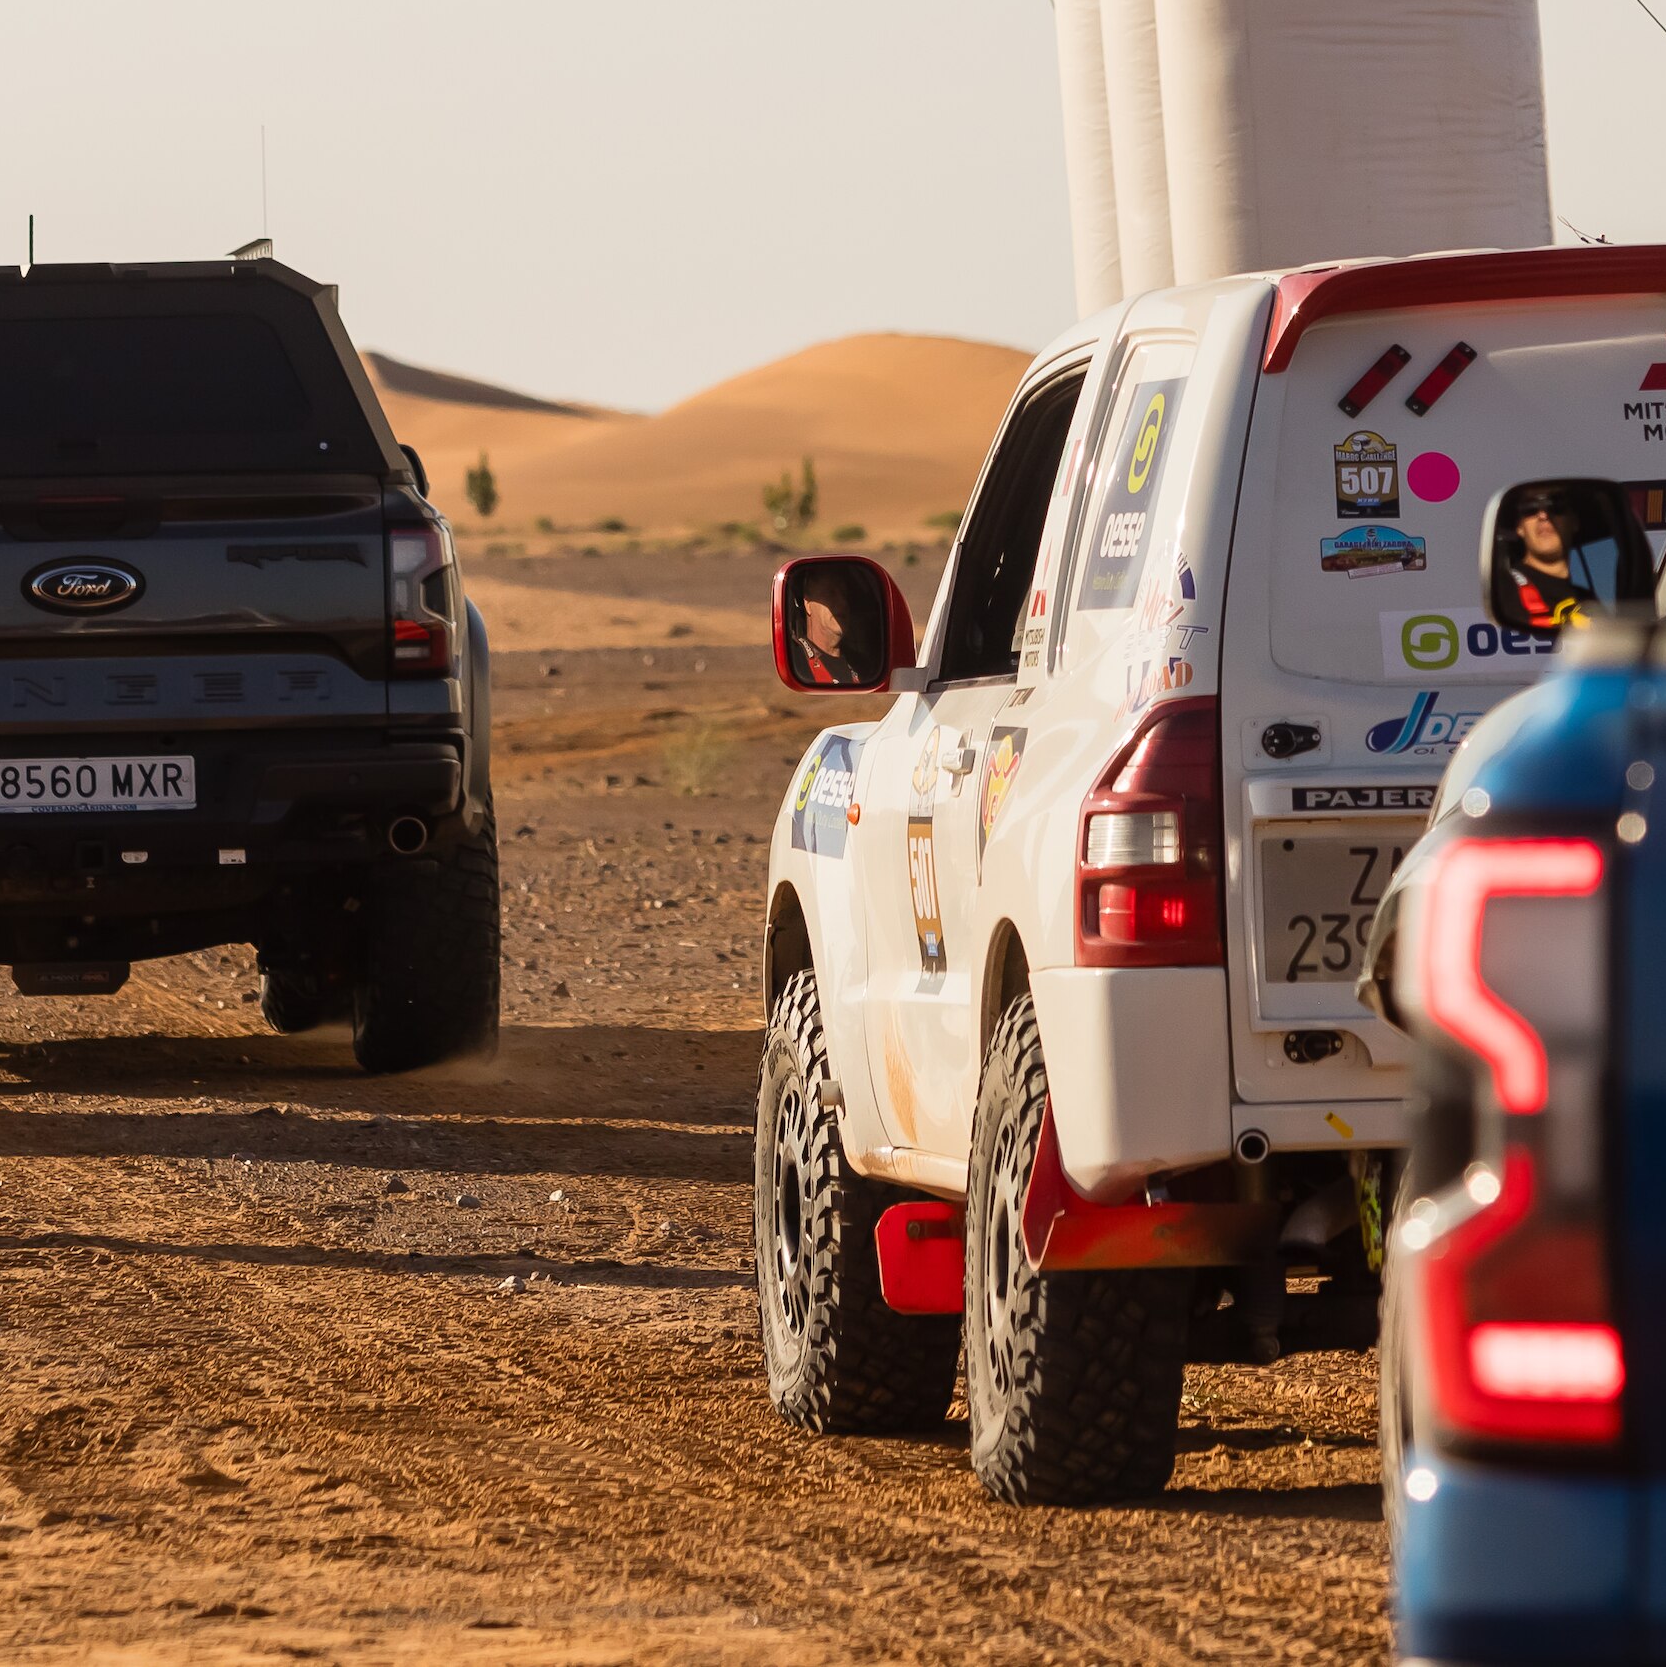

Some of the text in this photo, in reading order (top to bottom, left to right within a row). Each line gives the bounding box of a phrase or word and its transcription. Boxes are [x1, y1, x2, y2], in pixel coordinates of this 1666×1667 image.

[1341, 466, 1394, 495] 507
[1100, 511, 1146, 559] oesse
[57, 573, 112, 597] Ford
[0, 763, 183, 800] 8560 MXR
[809, 767, 857, 809] oesse
[909, 836, 938, 920] 507
